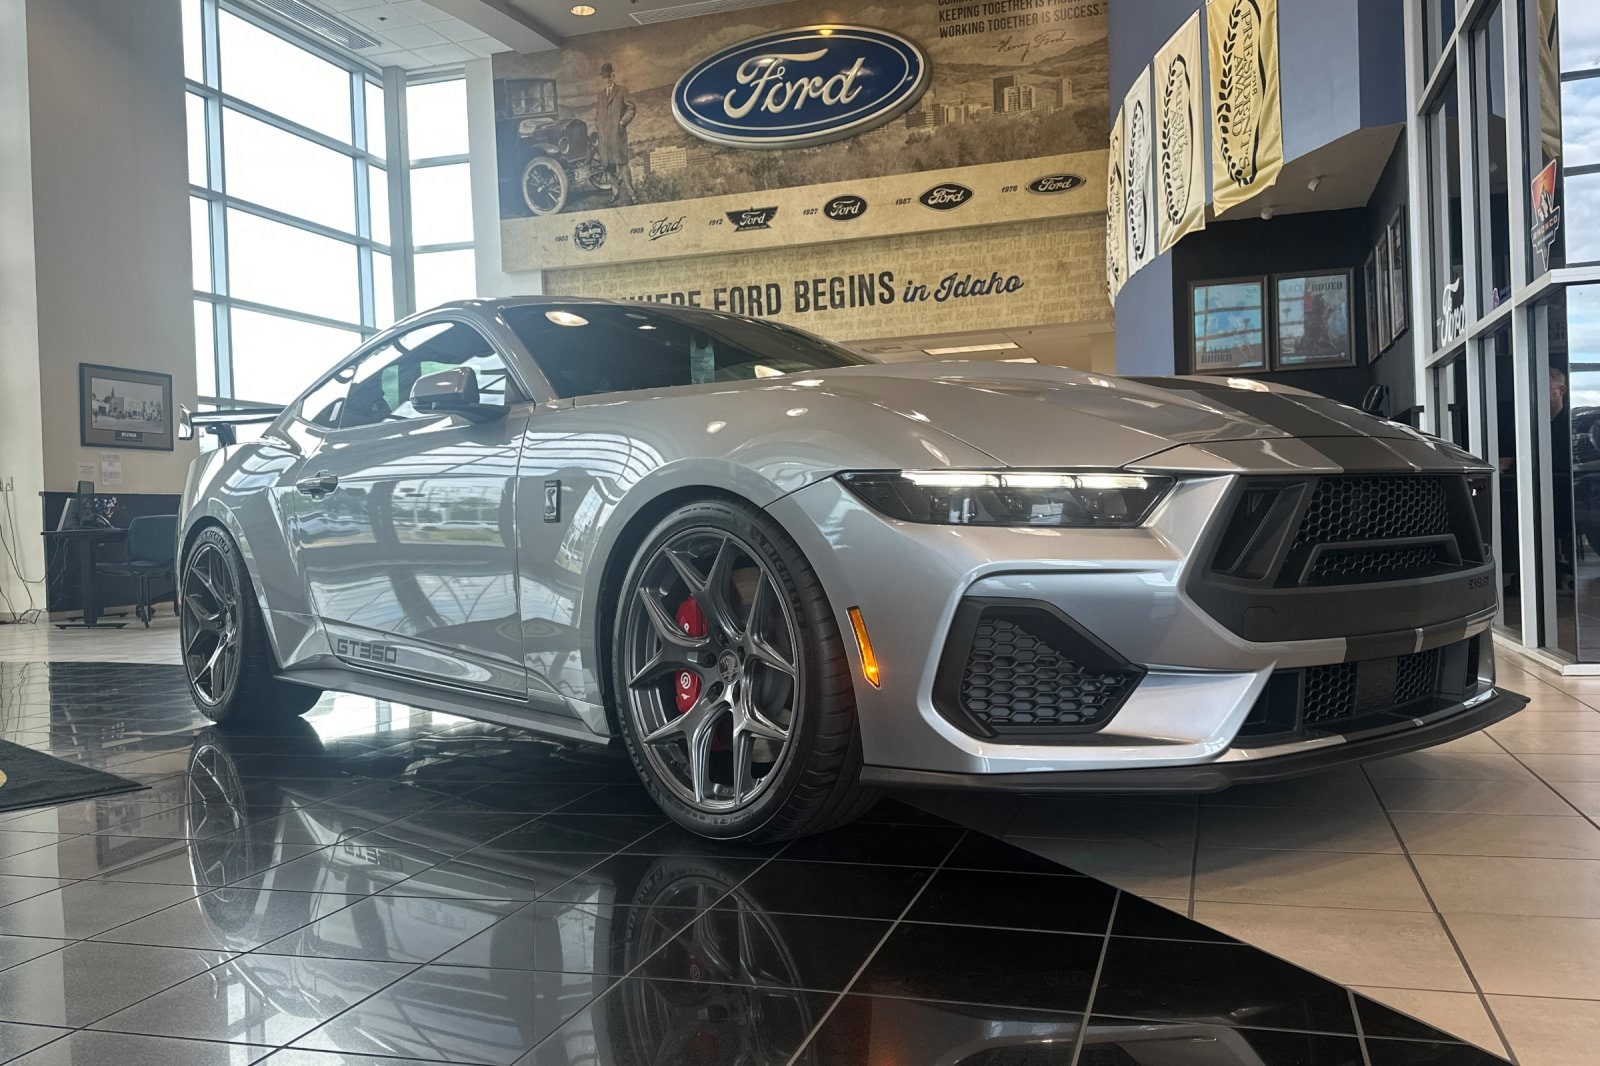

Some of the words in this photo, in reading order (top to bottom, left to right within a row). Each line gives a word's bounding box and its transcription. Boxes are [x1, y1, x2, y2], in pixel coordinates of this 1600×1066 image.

[939, 6, 980, 22] KEEPING
[983, 0, 1032, 16] TOGETHER
[939, 21, 985, 38] WORKING
[987, 13, 1038, 31] TOGETHER
[1041, 10, 1051, 23] IS
[724, 48, 866, 118] Ford
[1239, 9, 1254, 170] PRESIDENT'S
[1232, 54, 1246, 137] AWARD
[1038, 176, 1073, 191] Ford
[829, 199, 861, 217] Ford
[895, 197, 911, 206] 1957
[927, 187, 966, 206] Ford
[739, 211, 766, 226] Ford
[802, 207, 819, 216] 1927
[648, 216, 687, 242] Ford
[714, 282, 783, 316] FORD
[794, 270, 895, 313] BEGINS
[902, 280, 931, 303] in
[934, 272, 1025, 302] Idaho
[337, 638, 398, 664] GT350
